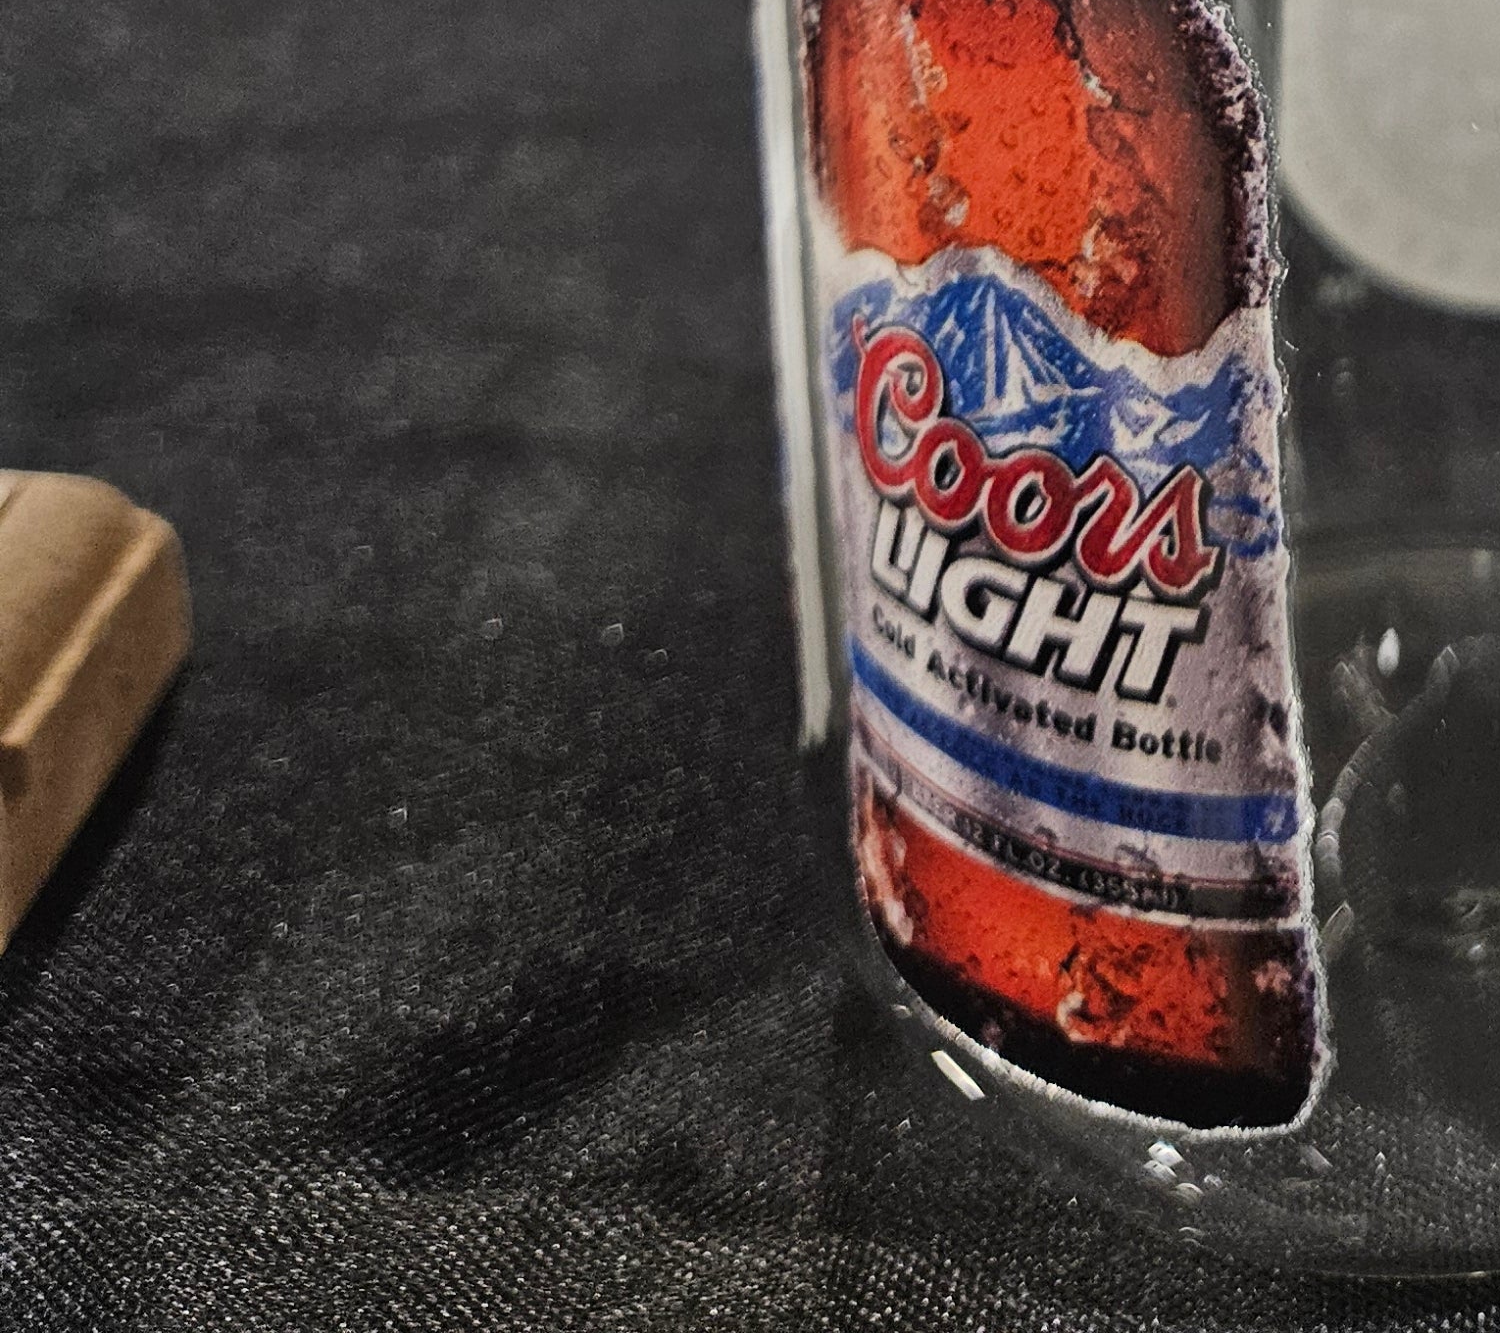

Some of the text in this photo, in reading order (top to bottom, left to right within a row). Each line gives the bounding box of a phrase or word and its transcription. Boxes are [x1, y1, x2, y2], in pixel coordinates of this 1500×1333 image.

[853, 309, 1222, 597] Coors
[870, 501, 1212, 705] LIGHT
[873, 603, 1223, 765] Cold Activated Bottle
